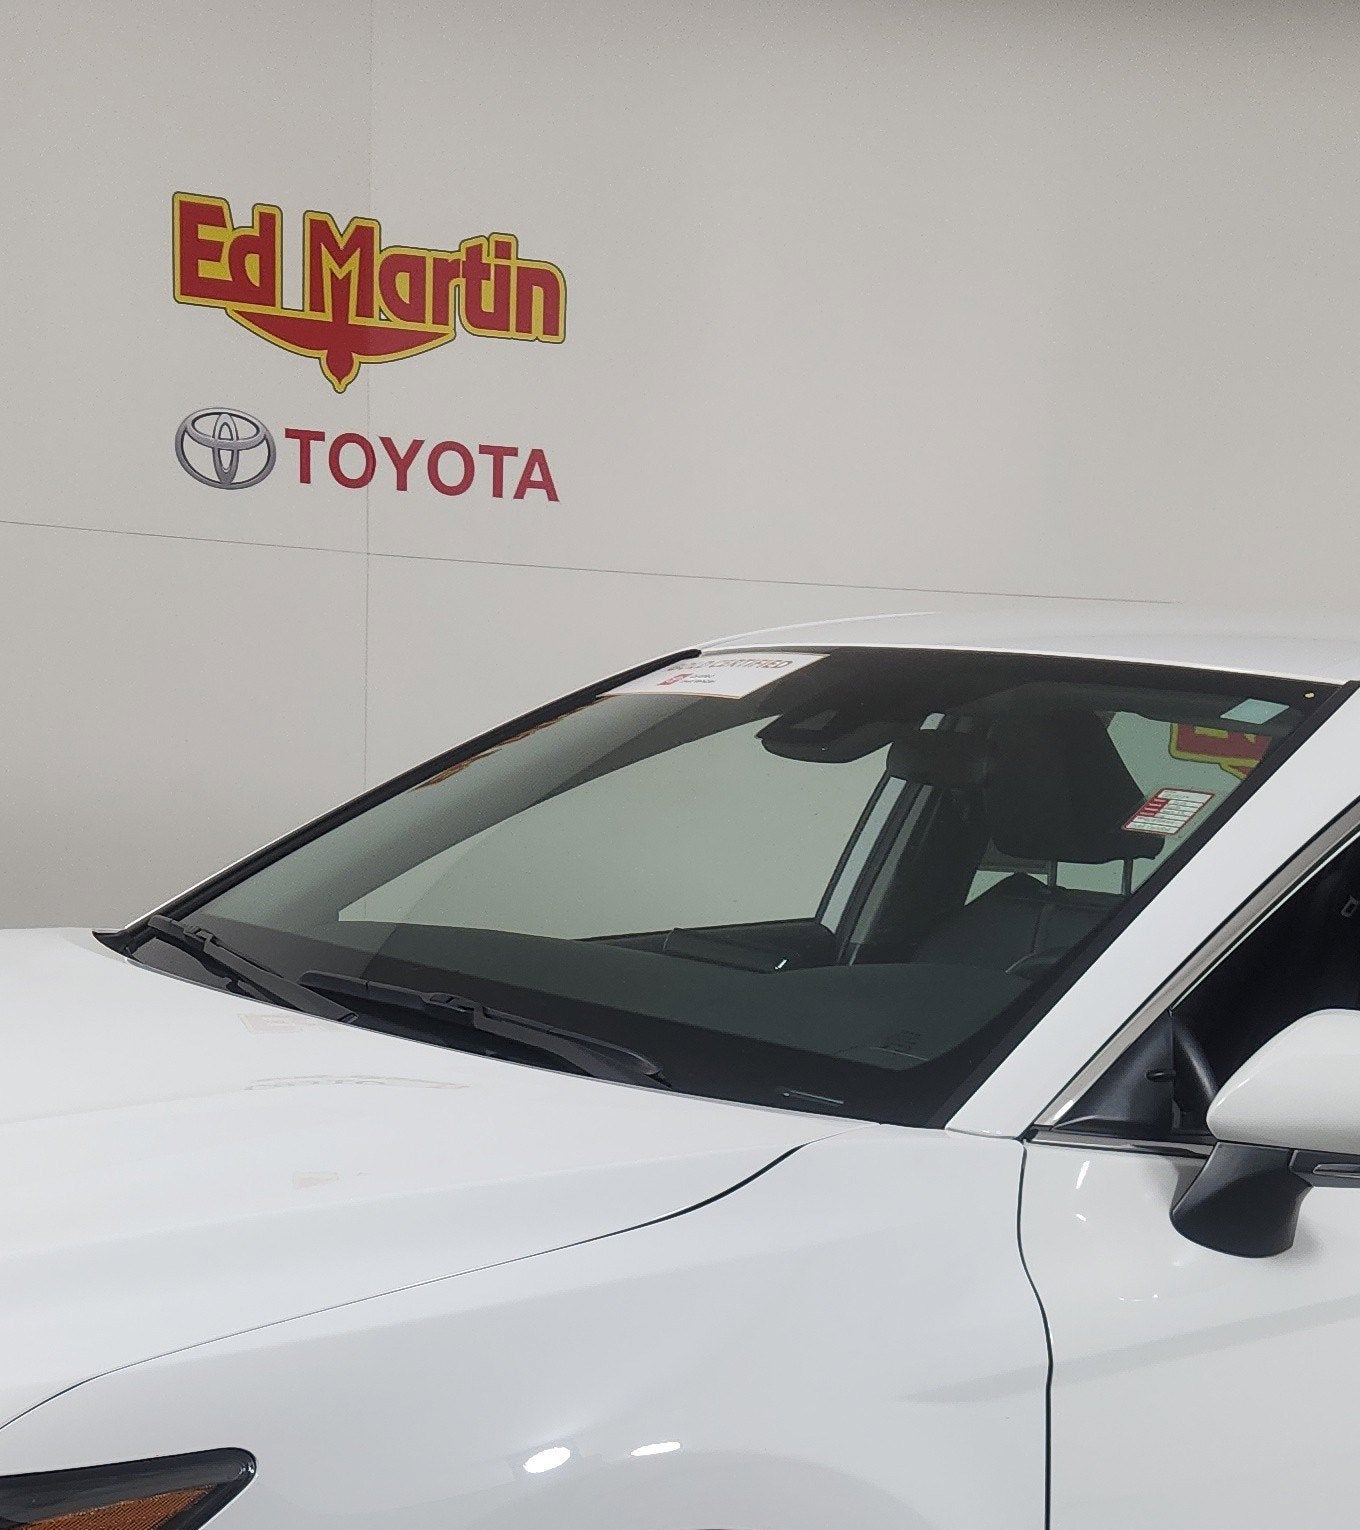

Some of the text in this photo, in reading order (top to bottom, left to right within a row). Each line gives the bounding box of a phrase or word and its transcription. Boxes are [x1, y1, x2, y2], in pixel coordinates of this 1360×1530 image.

[172, 191, 566, 344] Ed Martin
[284, 427, 560, 502] TOYOTA
